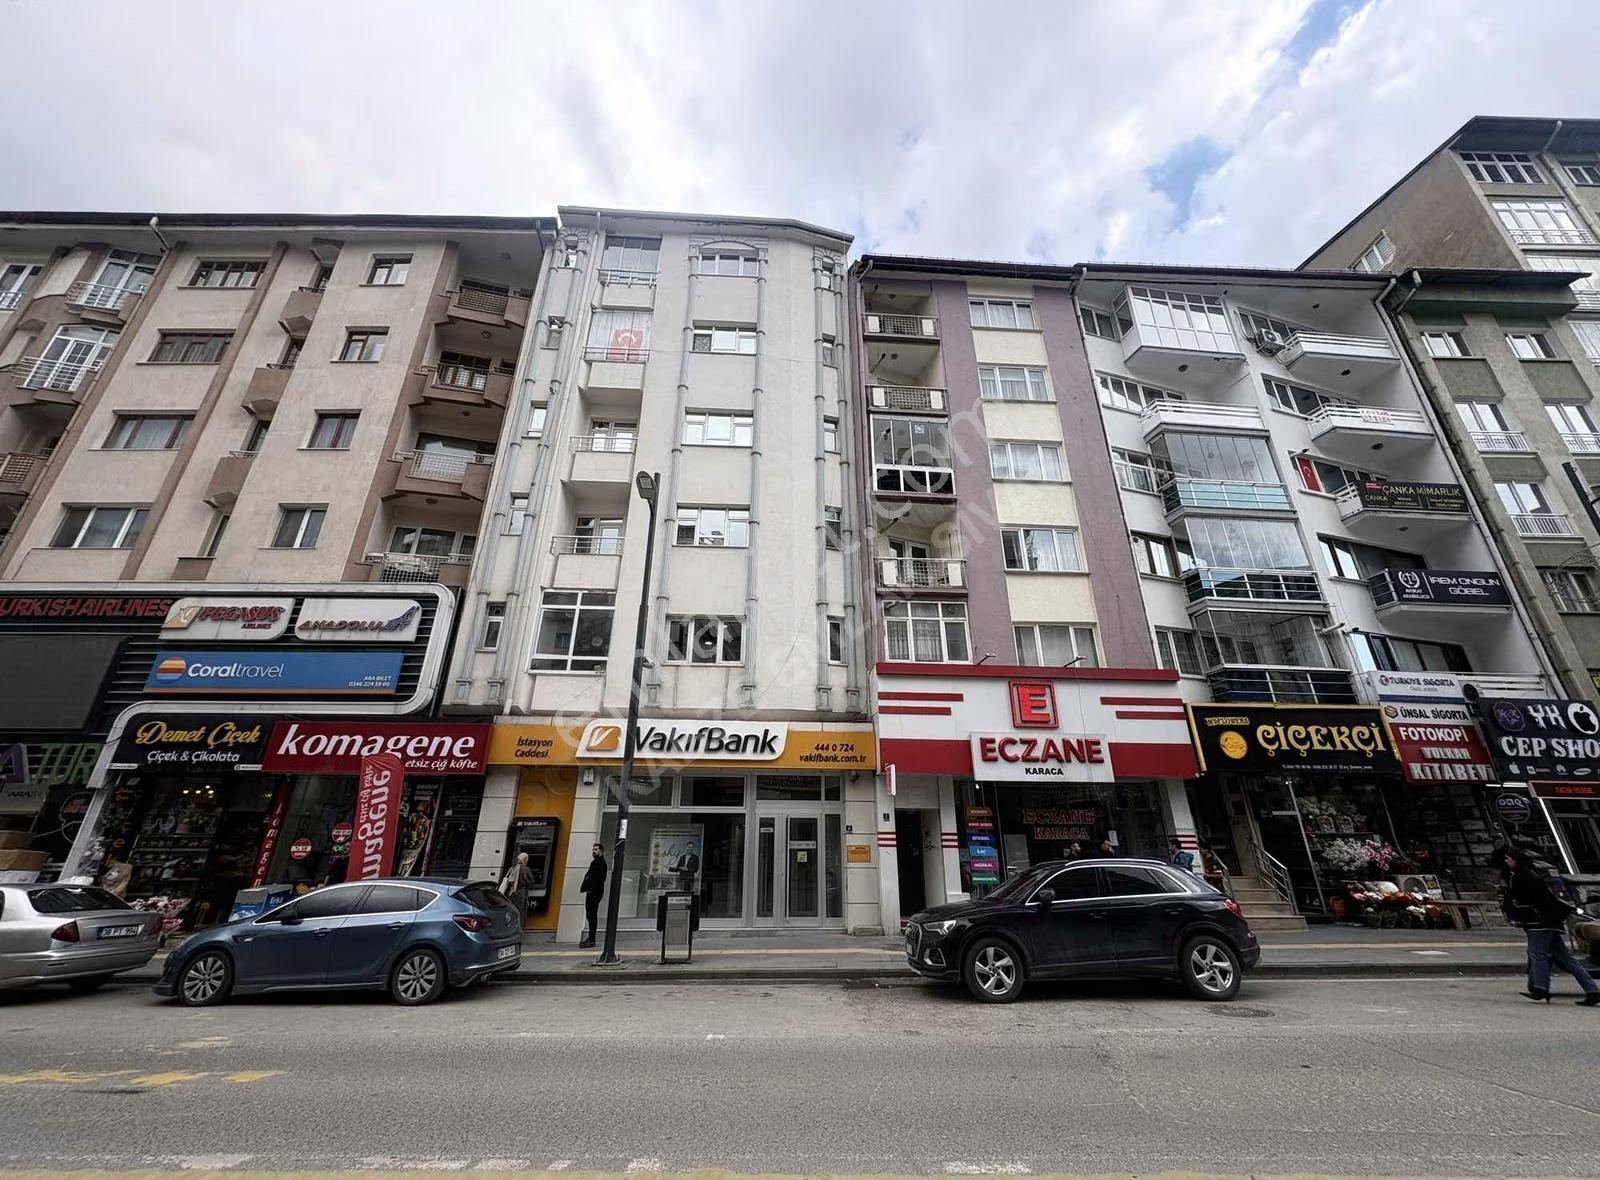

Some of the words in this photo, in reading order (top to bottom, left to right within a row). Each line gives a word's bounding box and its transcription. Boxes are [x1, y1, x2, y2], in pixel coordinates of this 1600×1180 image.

[0, 598, 172, 617] URKISHAIRLINES
[199, 605, 286, 622] PEGASUS
[1400, 706, 1430, 719] ÜNSAL
[1432, 707, 1469, 720] SİGORTA
[136, 720, 208, 744] Demet
[1256, 721, 1387, 758] ÇİÇEKÇİ
[1398, 726, 1469, 742] FOTOKOPİ
[277, 723, 475, 758] komagene
[517, 735, 553, 750] İstasyon
[814, 743, 830, 752] 444
[831, 743, 838, 752] 0
[839, 743, 855, 752] 724
[1501, 735, 1547, 757] CEP
[1551, 737, 1600, 758] SHO
[180, 751, 189, 762] &
[514, 748, 549, 759] Caddesi
[979, 736, 1106, 764] ECZANE
[405, 758, 430, 769] etsiz
[431, 758, 447, 771] çiğ
[449, 757, 478, 770] köfte
[1024, 767, 1064, 777] KARACA
[1408, 762, 1497, 781] KİTABEVİ
[1023, 809, 1096, 825] ECZANE
[1033, 826, 1091, 840] KARACA
[251, 802, 283, 887] komagen
